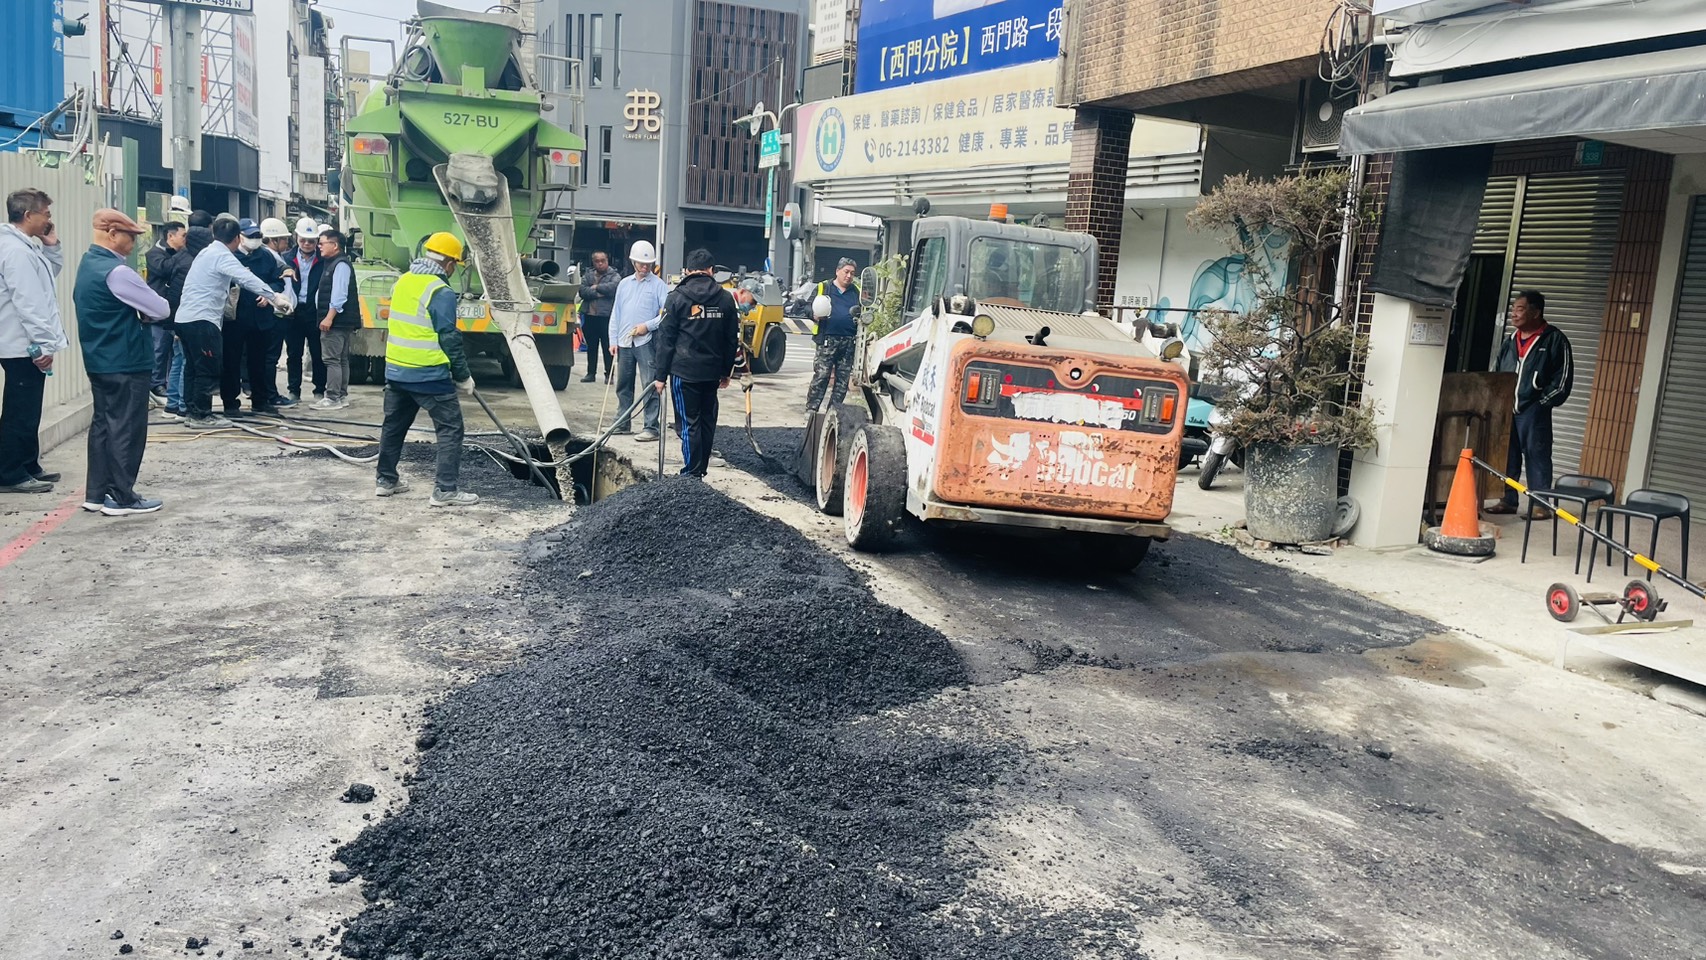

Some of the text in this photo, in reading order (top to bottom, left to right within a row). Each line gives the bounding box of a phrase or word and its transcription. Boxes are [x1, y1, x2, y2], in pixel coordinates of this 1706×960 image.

[880, 7, 1062, 82] 【西門分院】 西門路一段
[444, 112, 499, 128] 527-BU
[879, 136, 949, 159] 06-2143382
